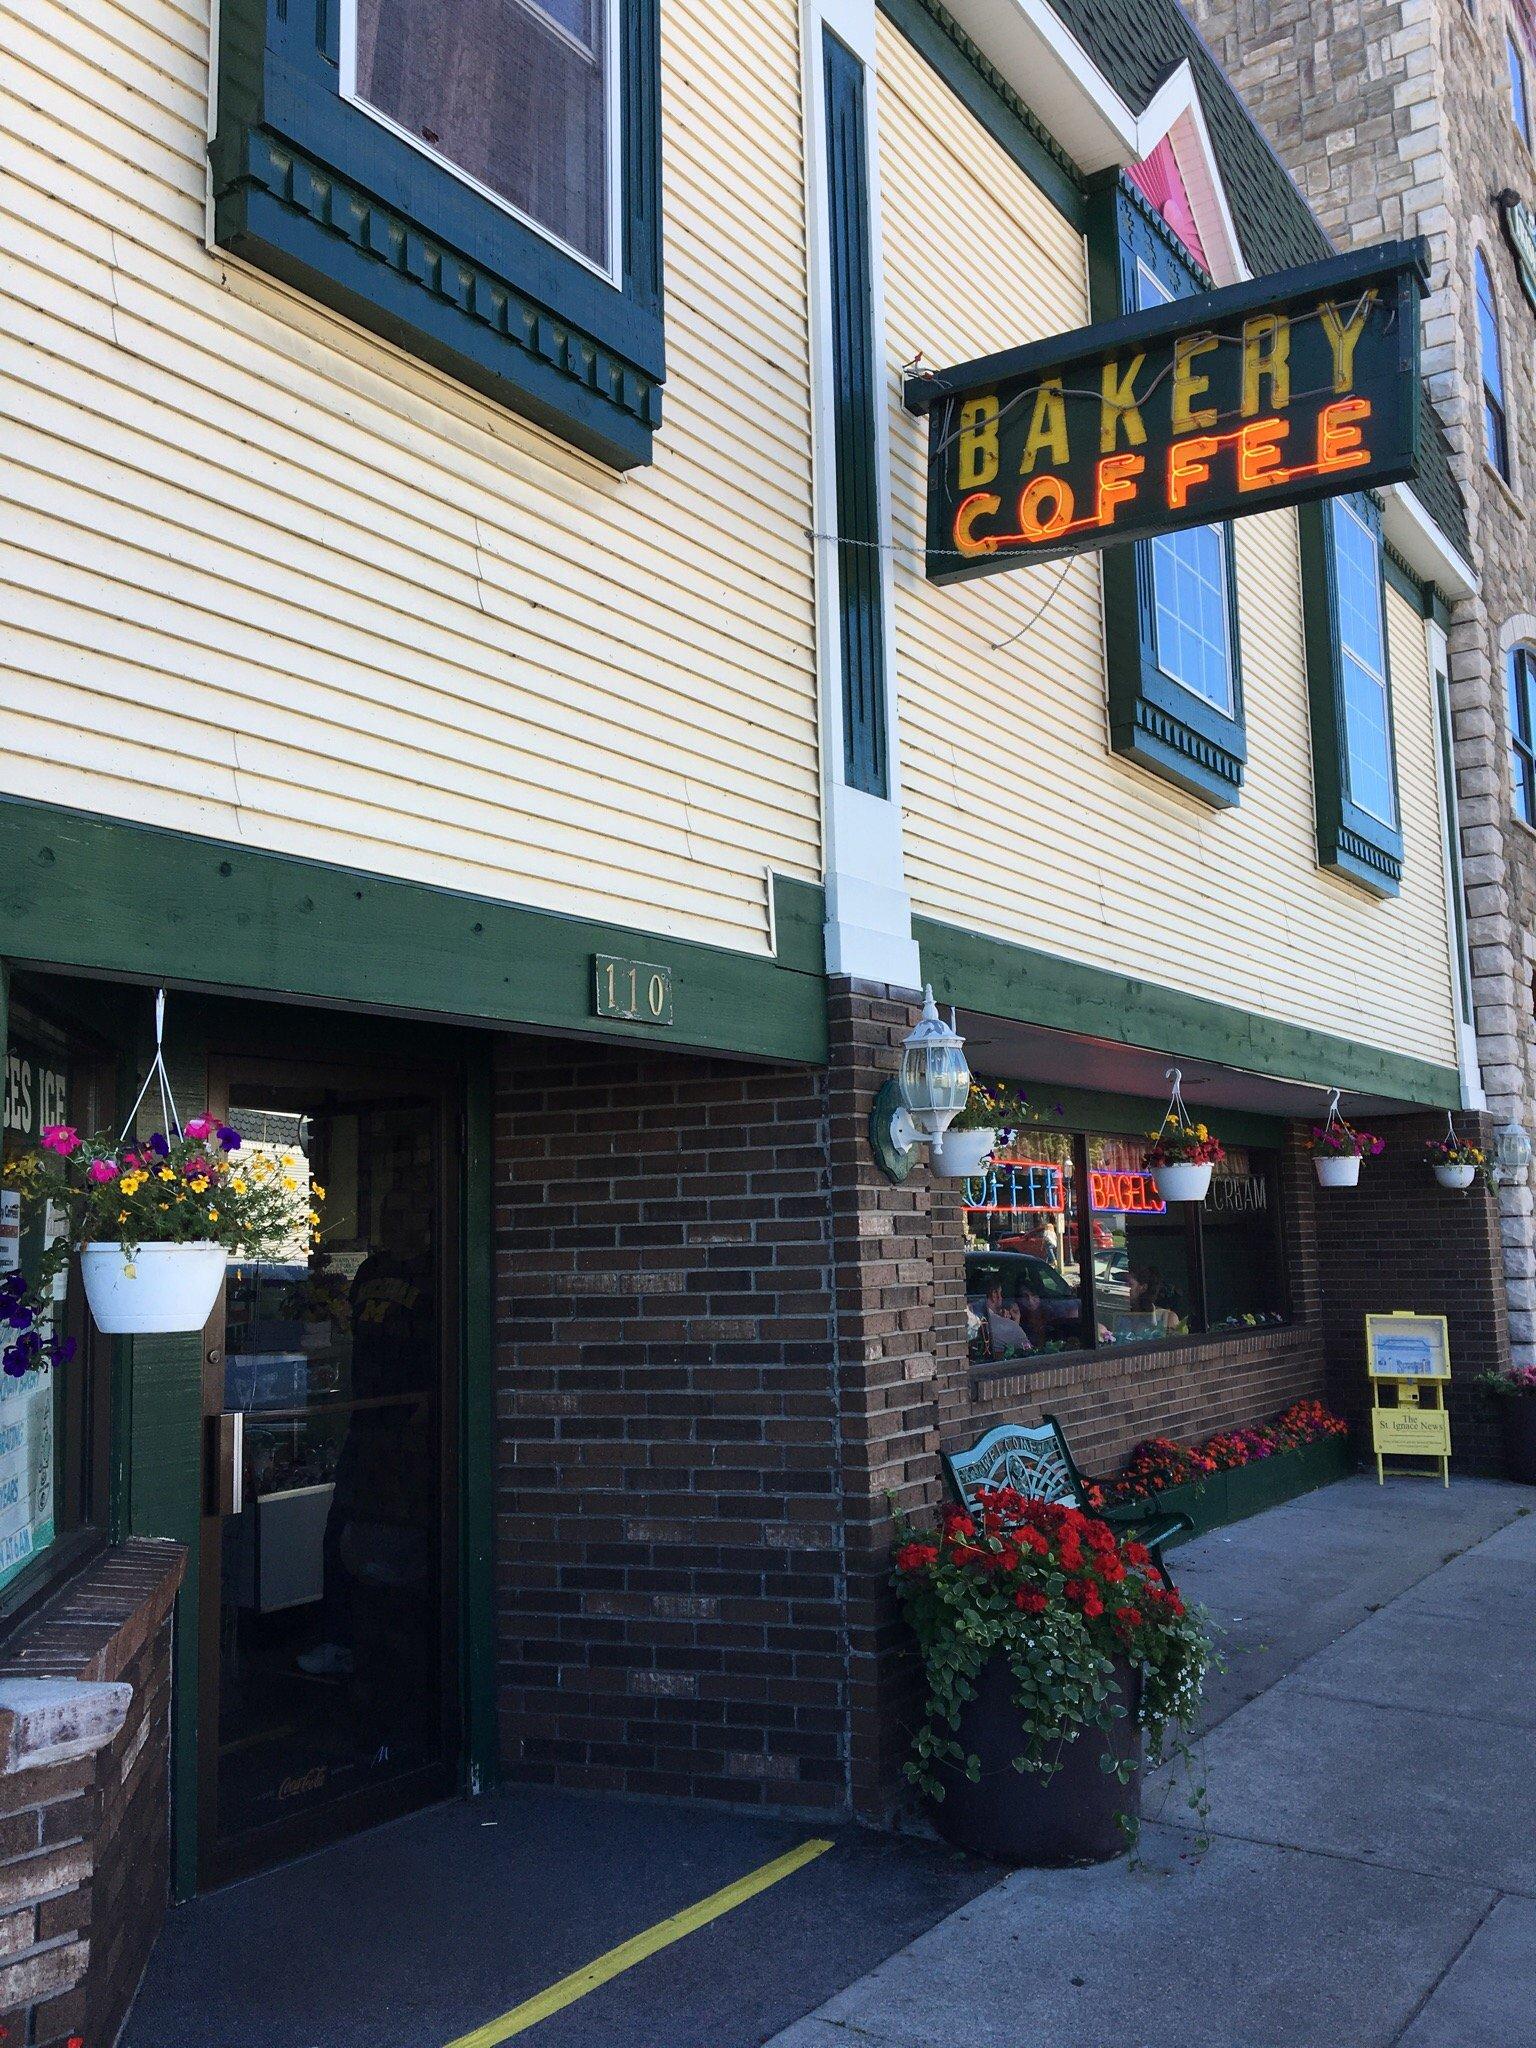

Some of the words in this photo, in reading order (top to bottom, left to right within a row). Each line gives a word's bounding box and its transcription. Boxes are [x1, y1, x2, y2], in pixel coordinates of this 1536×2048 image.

[958, 289, 1378, 490] BAKERY
[953, 396, 1371, 557] COFFEE
[606, 963, 664, 1016] 110
[39, 1068, 66, 1136] ICE
[1393, 1421, 1418, 1432] Ignace
[1420, 1422, 1444, 1431] News
[1402, 1415, 1418, 1424] The
[981, 1436, 1038, 1472] WELCOME
